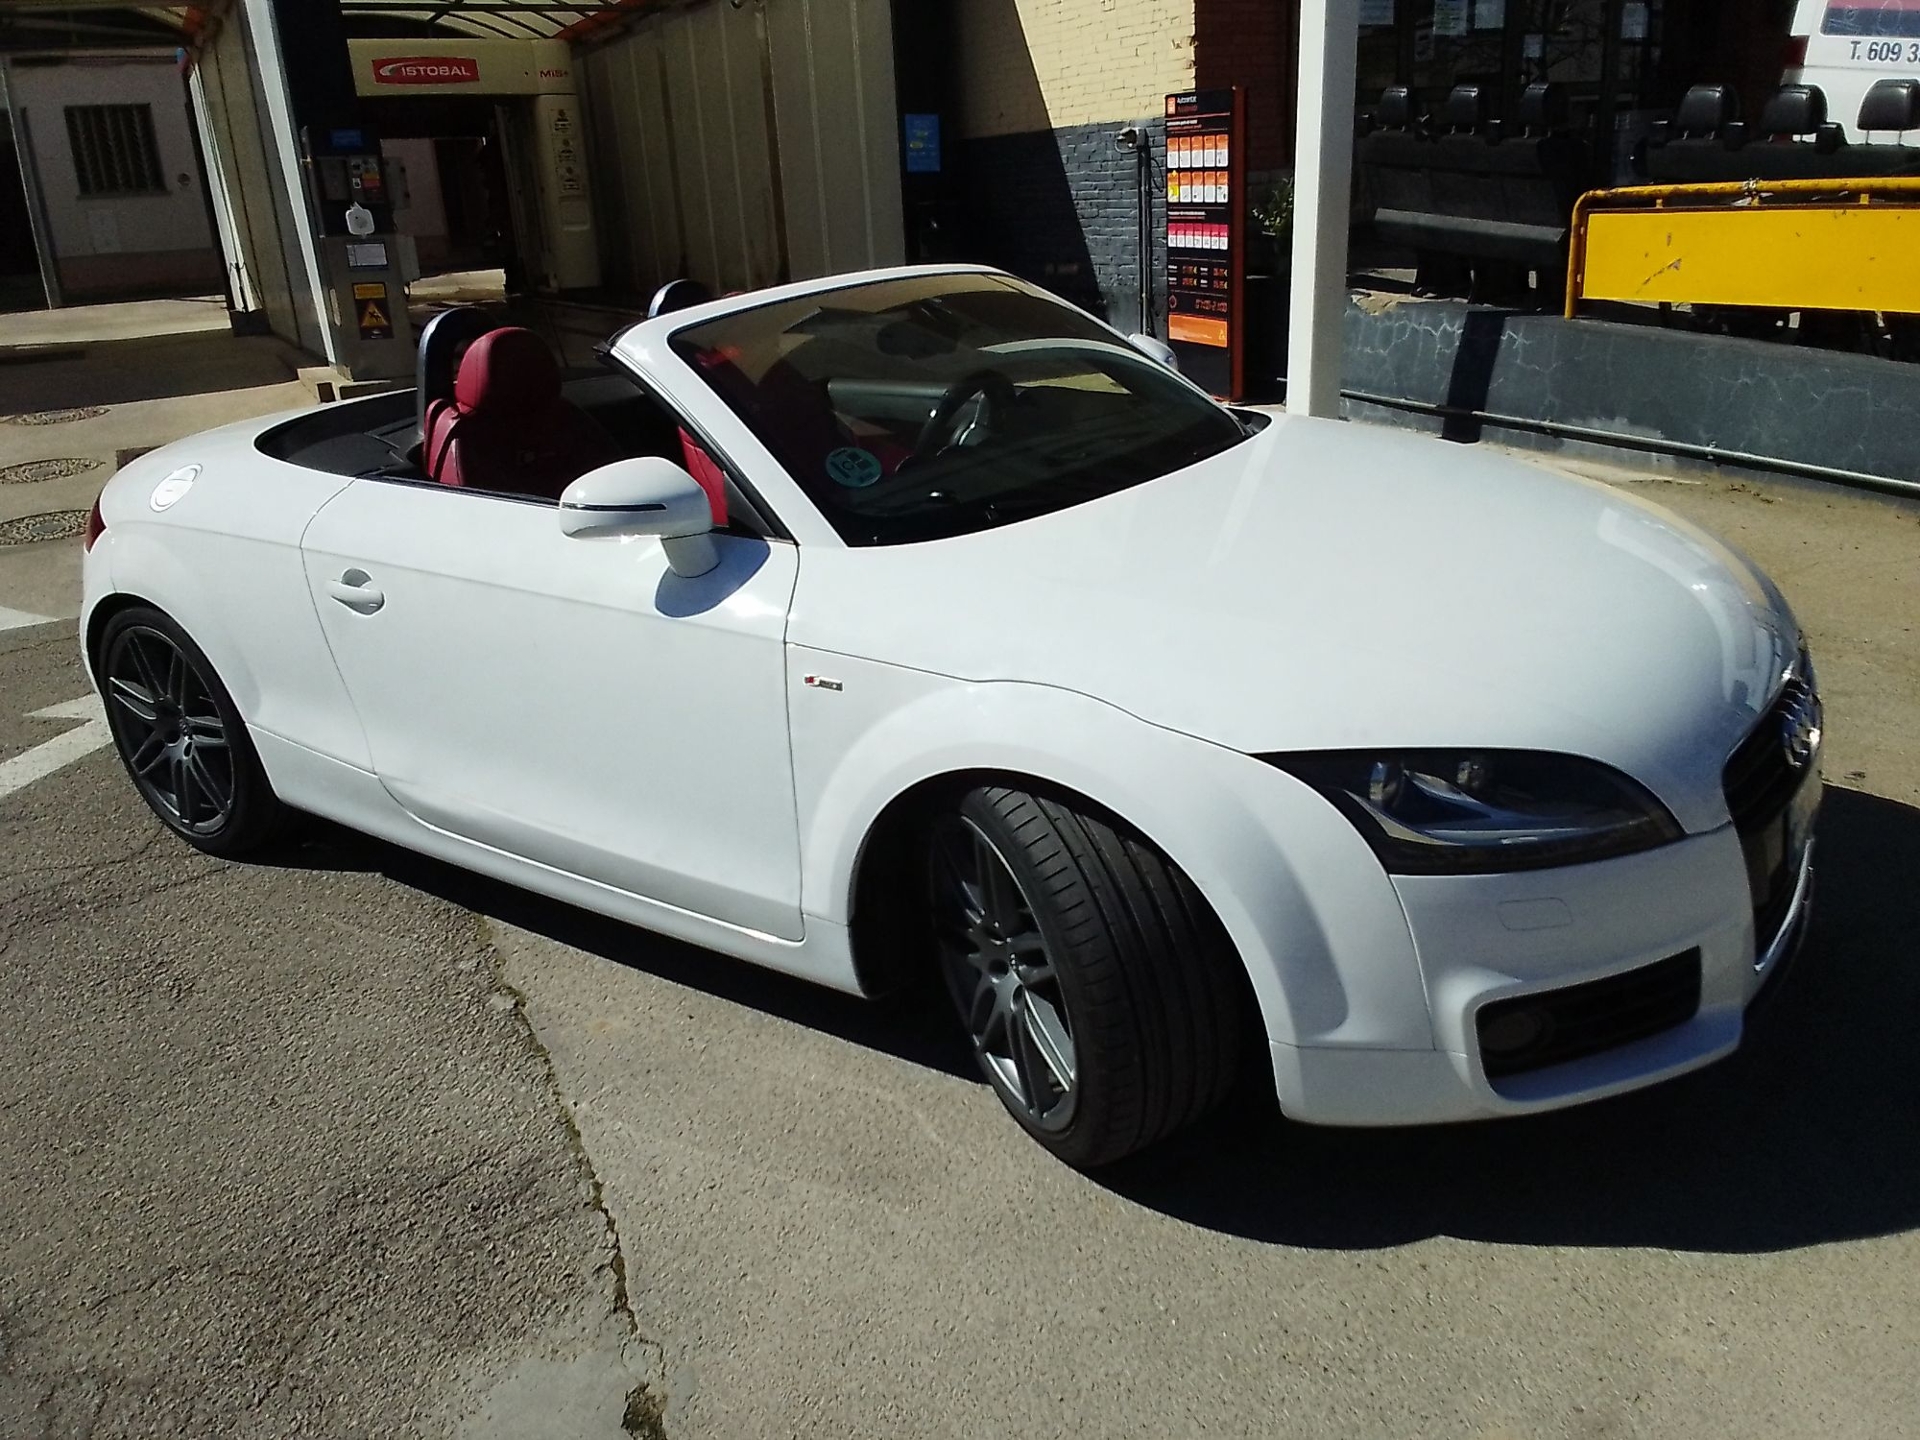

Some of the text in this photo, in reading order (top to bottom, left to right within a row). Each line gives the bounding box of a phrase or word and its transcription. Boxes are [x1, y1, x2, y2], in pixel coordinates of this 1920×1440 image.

[1850, 40, 1920, 63] T. 609 3
[401, 65, 472, 77] ISTOBAL
